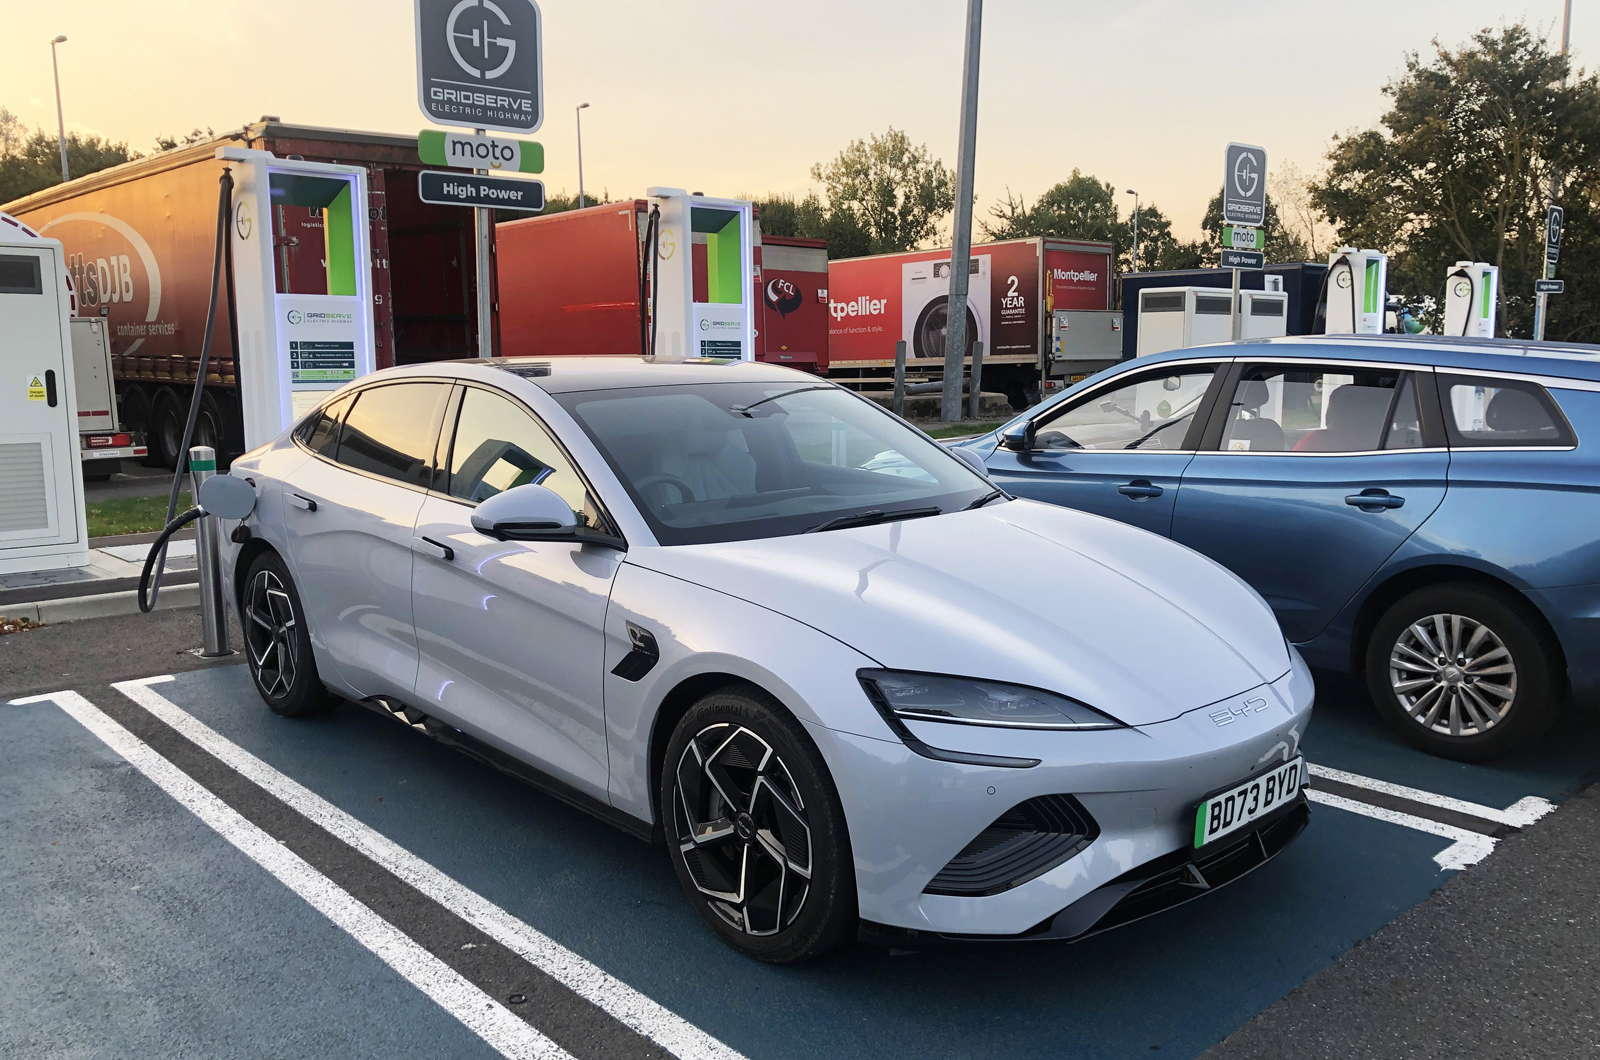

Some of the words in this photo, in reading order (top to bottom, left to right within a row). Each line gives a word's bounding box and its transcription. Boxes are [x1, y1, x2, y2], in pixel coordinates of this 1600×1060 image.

[431, 87, 532, 112] GRIDSERVE
[431, 103, 482, 116] ELECTRIC
[487, 110, 532, 122] HIGHWAY
[452, 139, 514, 162] moto
[443, 182, 476, 199] High
[480, 186, 523, 201] Power
[1227, 203, 1262, 214] GRIDSERVE
[1233, 231, 1255, 243] moto
[1228, 255, 1241, 264] High
[1241, 256, 1257, 265] Power
[1053, 268, 1098, 283] Montpellier
[779, 278, 795, 295] FCL
[1007, 275, 1019, 297] 2
[1001, 296, 1025, 308] YEAR
[117, 322, 147, 336] container
[148, 320, 175, 335] services
[696, 703, 743, 720] Continental
[1208, 696, 1268, 727] BYD
[1208, 782, 1260, 836] BD73
[1263, 763, 1298, 809] BYD
